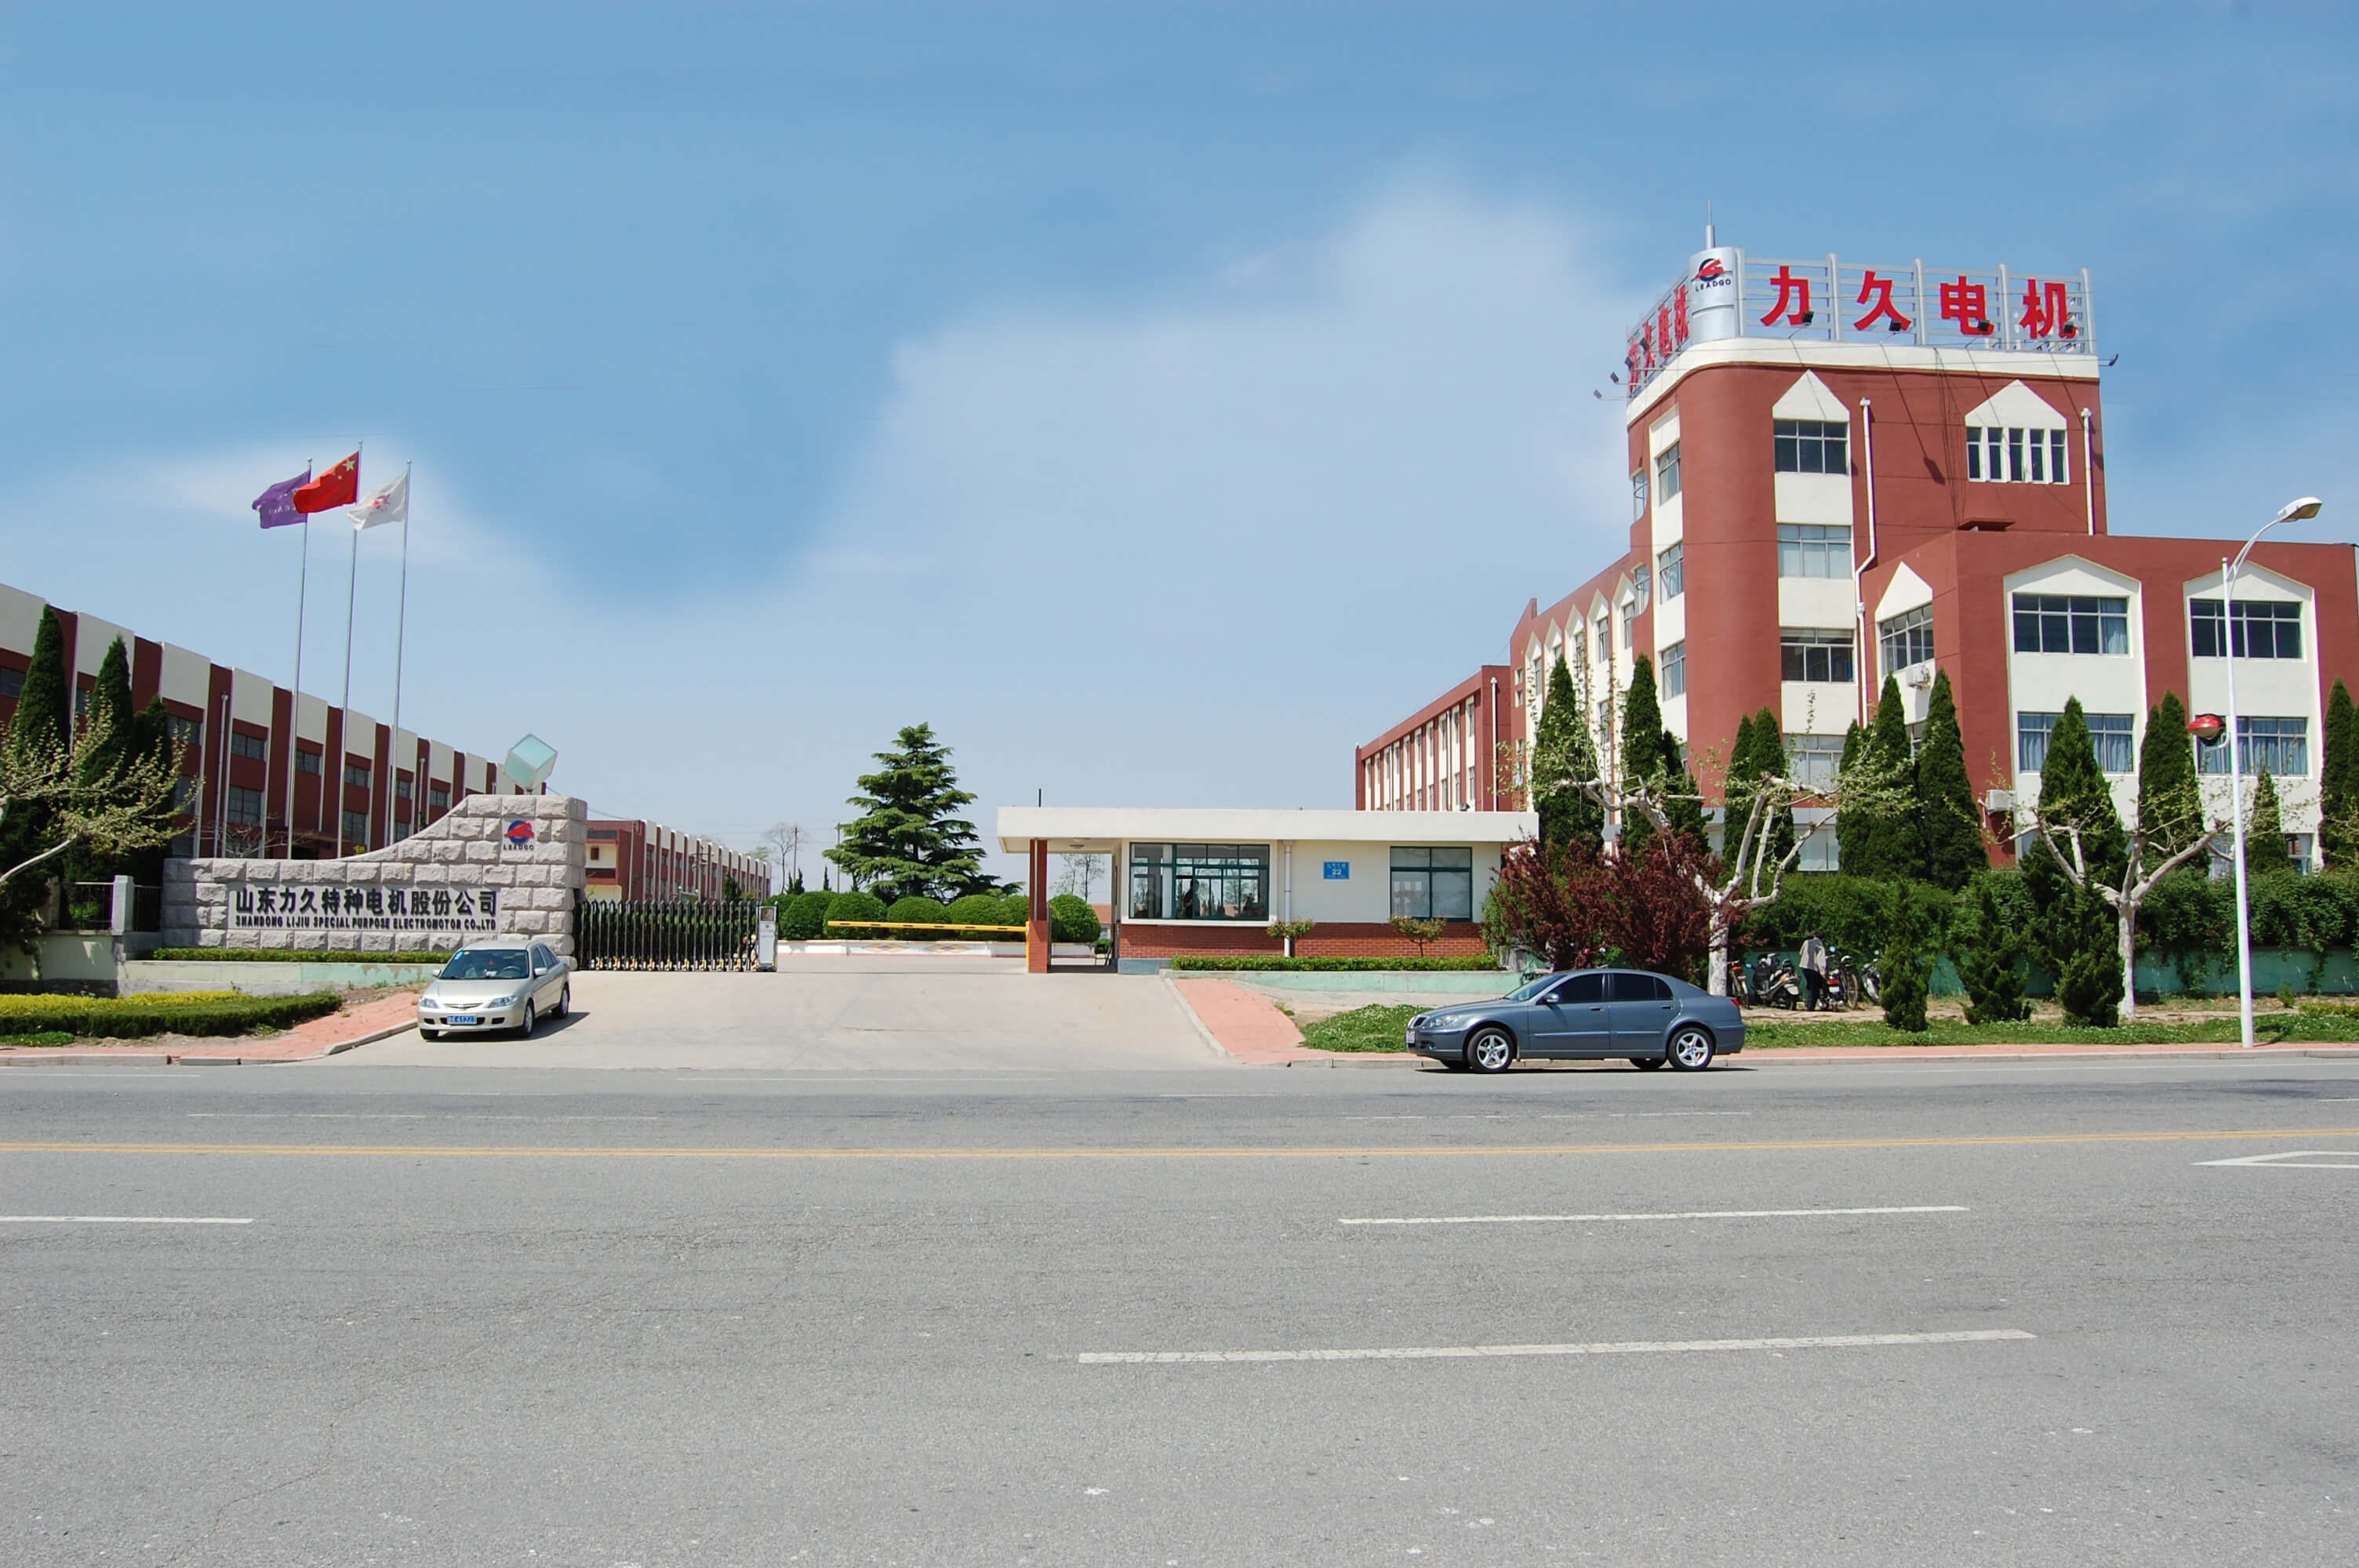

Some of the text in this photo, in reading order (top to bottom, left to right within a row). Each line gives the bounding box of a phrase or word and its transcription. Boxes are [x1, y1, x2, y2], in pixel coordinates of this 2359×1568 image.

[1695, 278, 1732, 292] LEADGO
[1761, 265, 2077, 339] 力久电机
[236, 887, 497, 917] 山东力久特种电机股份公司
[235, 915, 283, 928] SHANDONG
[286, 916, 310, 928] LIJIU
[314, 916, 351, 929] SPECIAL
[352, 917, 390, 930] PURPOSE
[393, 917, 461, 931] ELECTROMOTOR
